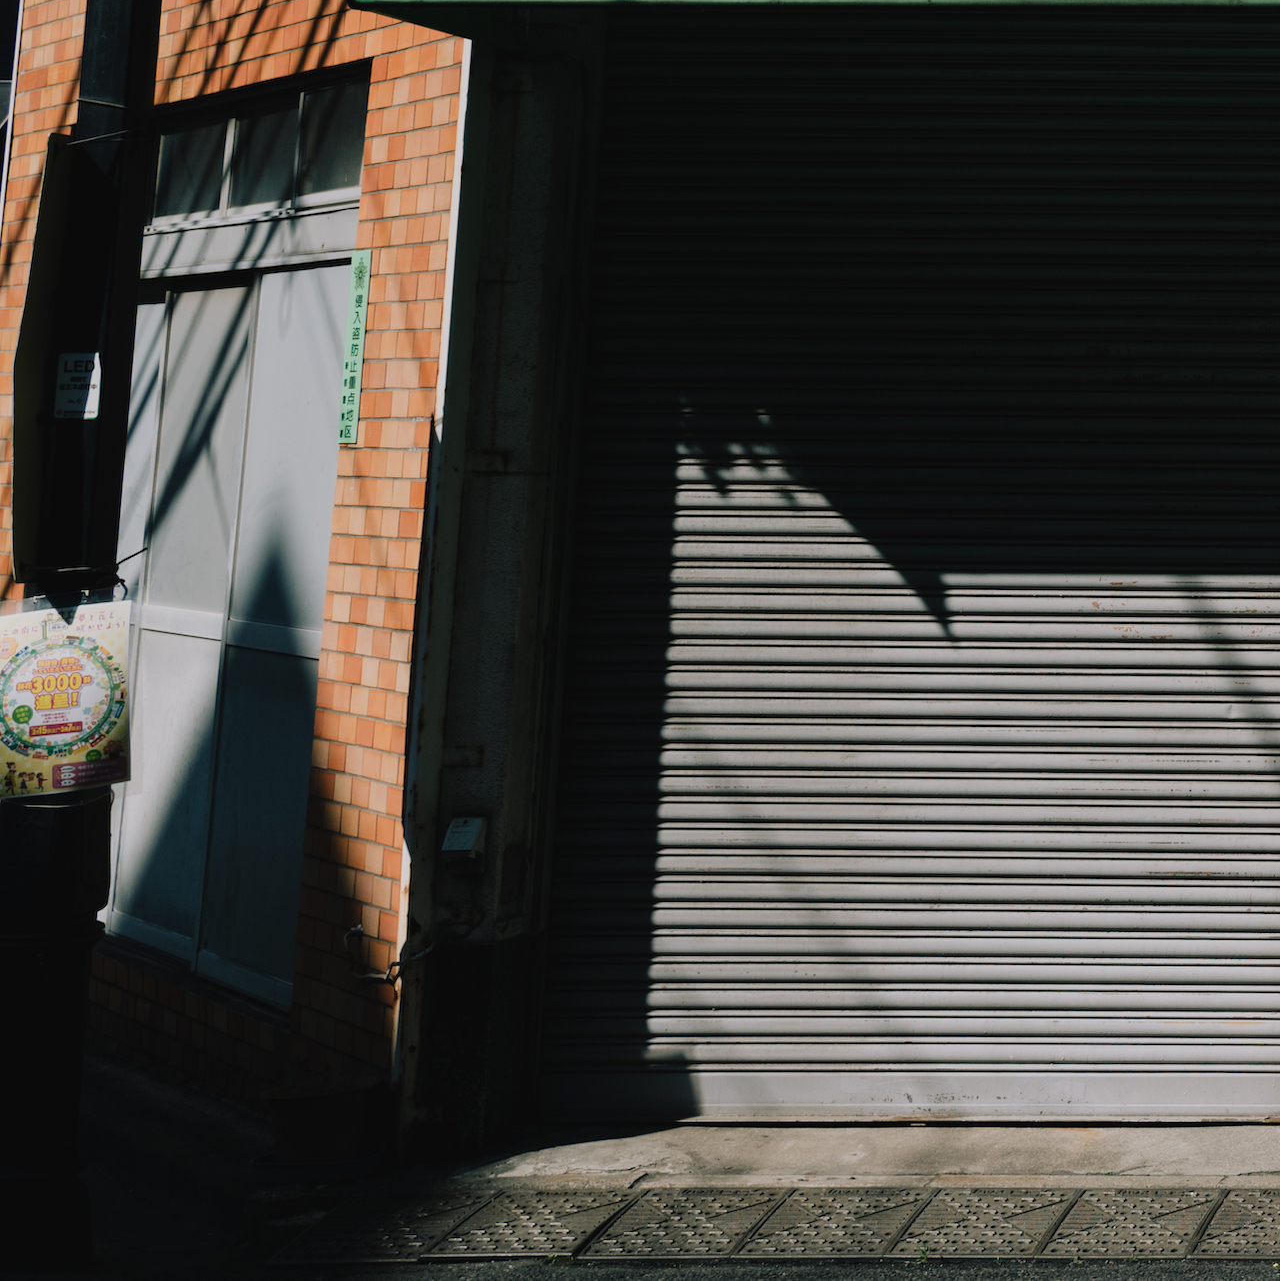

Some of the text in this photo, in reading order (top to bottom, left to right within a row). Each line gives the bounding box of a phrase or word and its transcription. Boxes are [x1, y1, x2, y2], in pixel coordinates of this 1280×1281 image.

[64, 360, 95, 373] LED
[343, 294, 363, 439] 侵入盗防止重点地区
